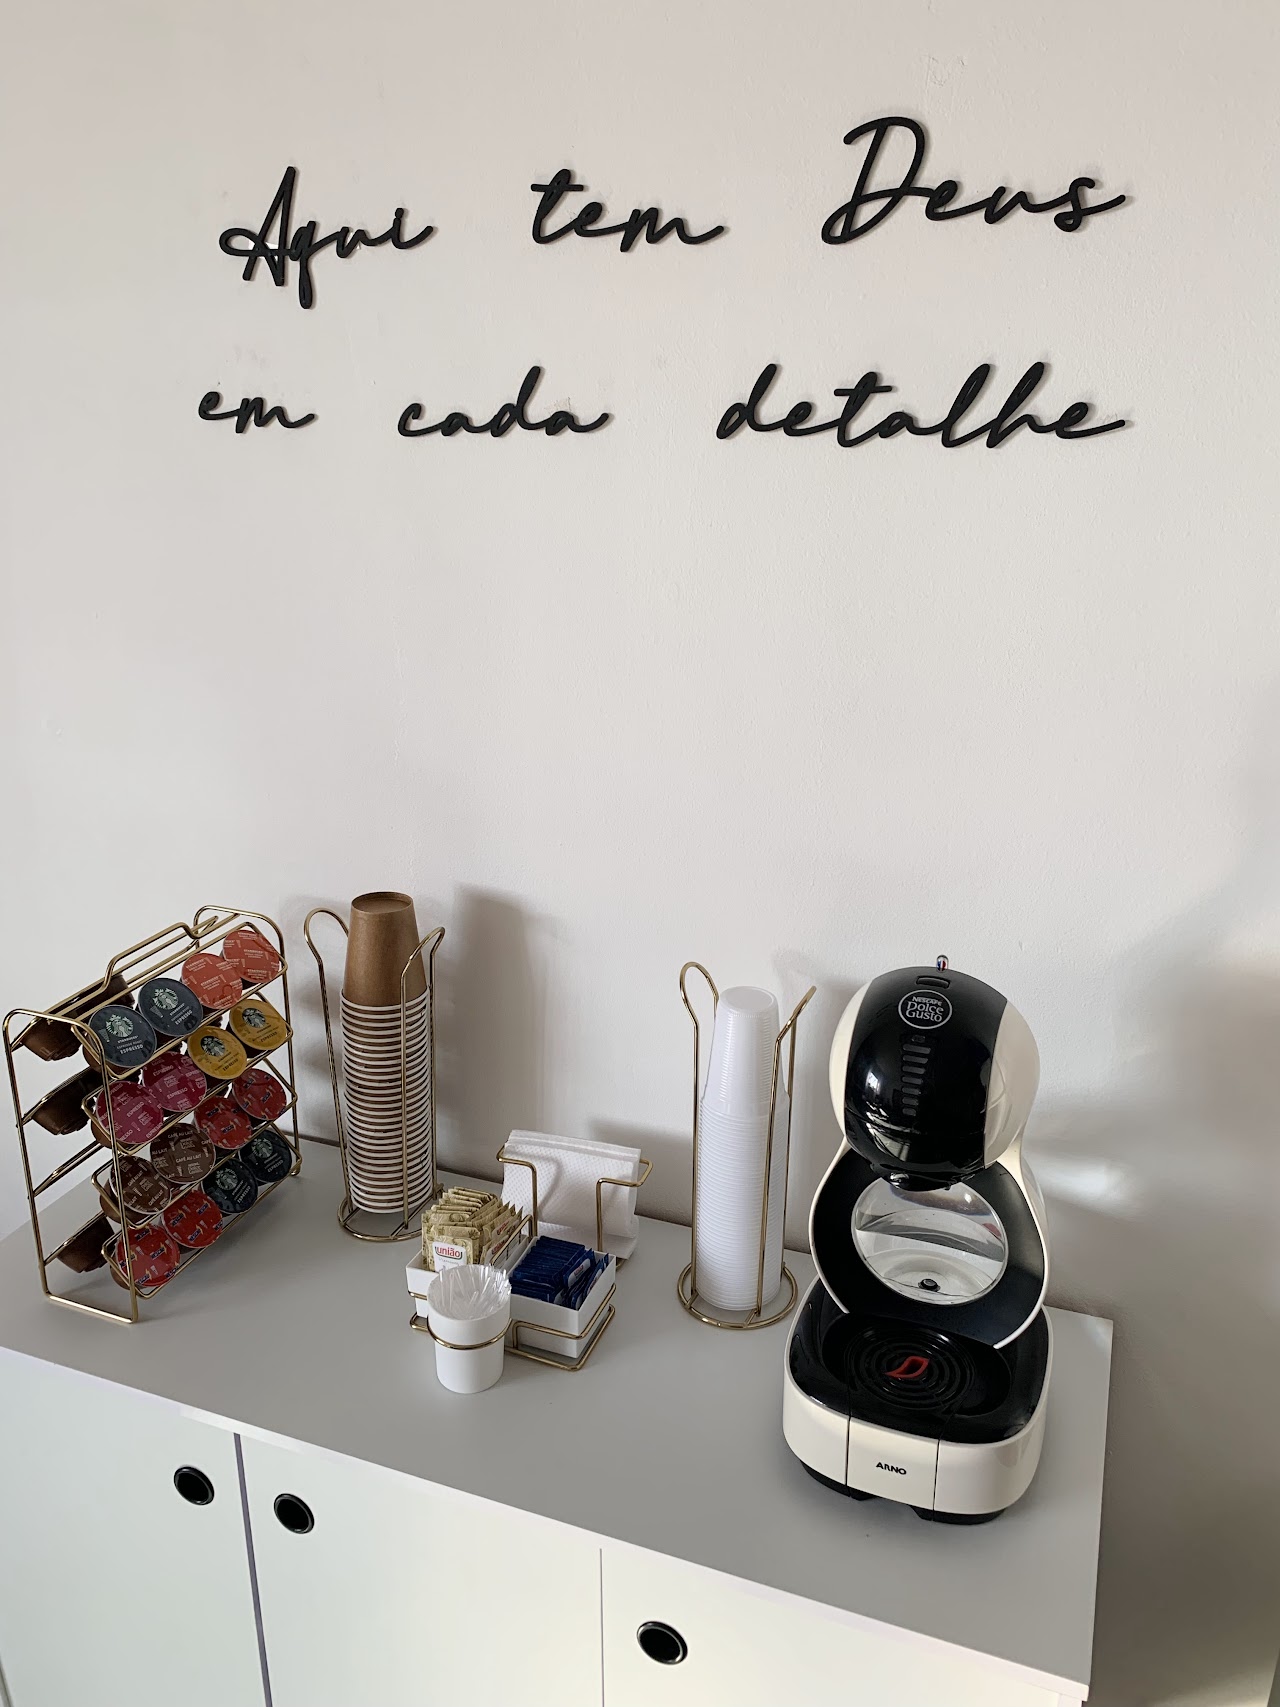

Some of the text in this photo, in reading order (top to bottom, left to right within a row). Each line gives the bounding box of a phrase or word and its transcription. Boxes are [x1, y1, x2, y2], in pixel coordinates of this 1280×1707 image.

[219, 116, 1126, 310] Aqui tem Deus
[199, 361, 1126, 449] em cada detalhe
[120, 1044, 144, 1054] ESPRESSO
[167, 1087, 188, 1100] ESPRESSO
[126, 1101, 145, 1117] ESPRESSO
[436, 1246, 461, 1258] união
[875, 1461, 907, 1475] ARNO
